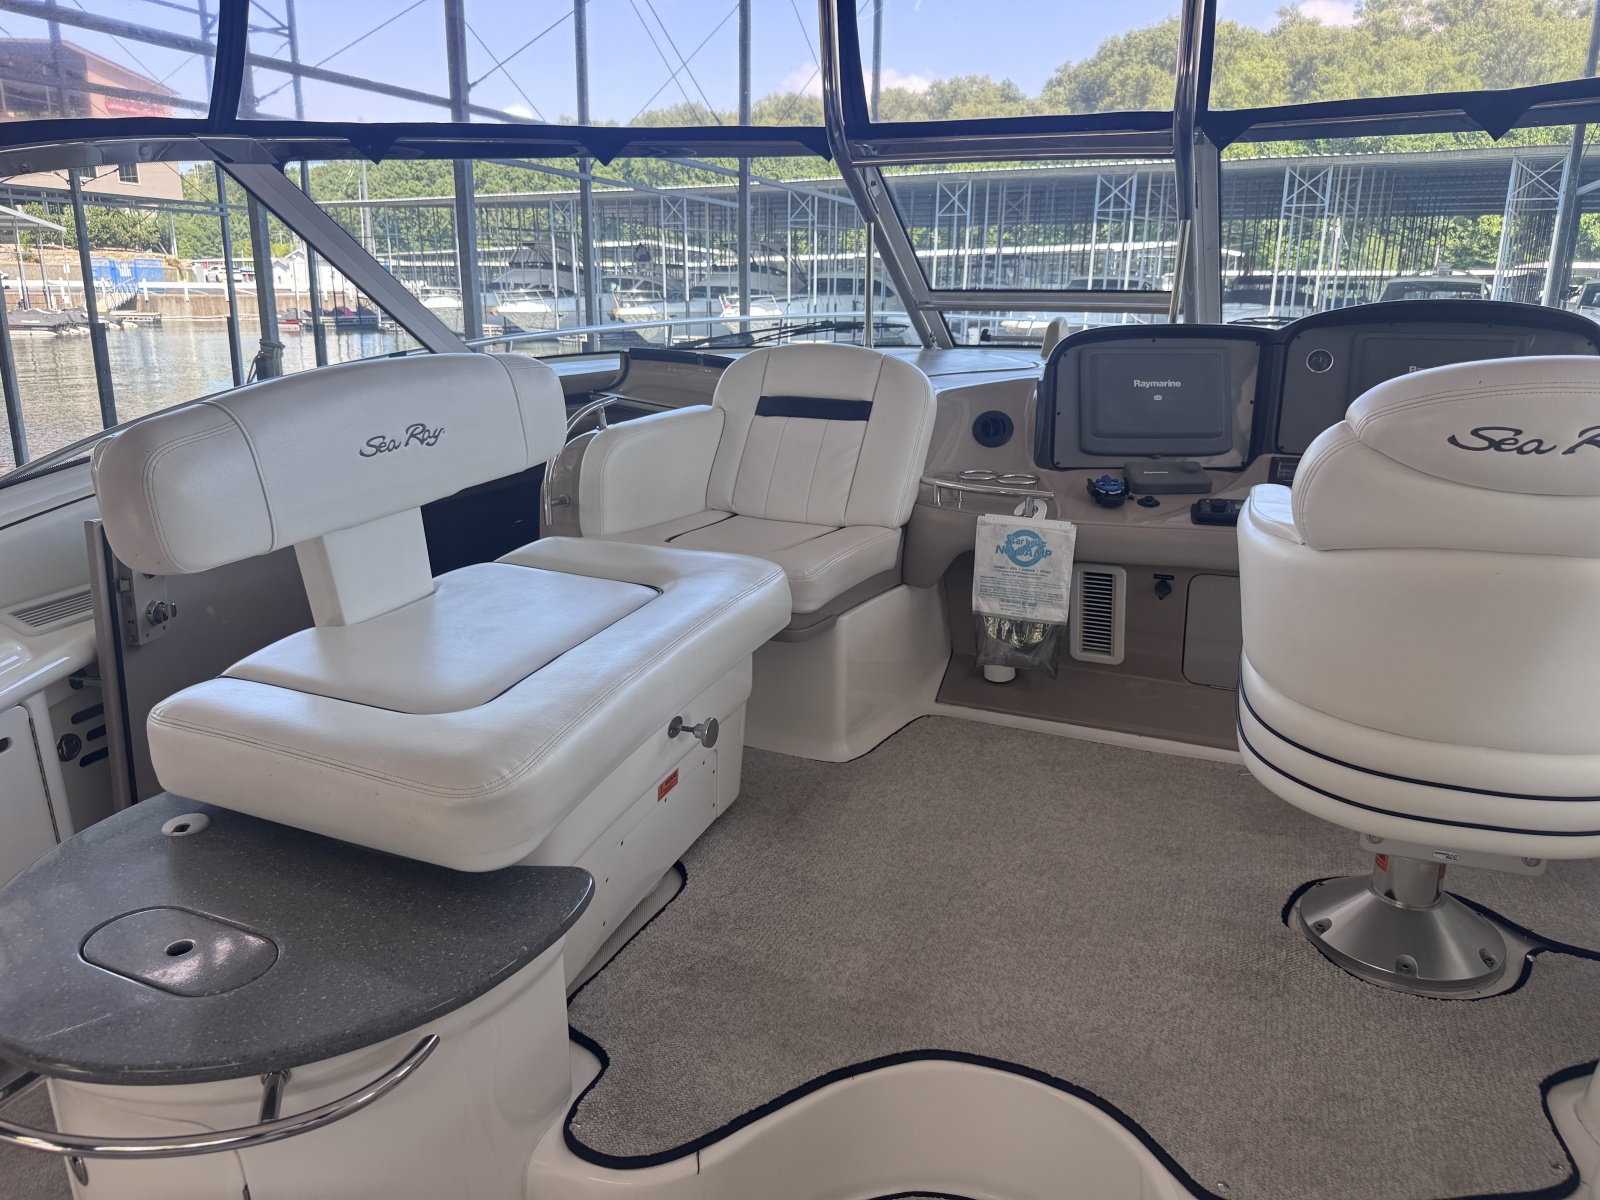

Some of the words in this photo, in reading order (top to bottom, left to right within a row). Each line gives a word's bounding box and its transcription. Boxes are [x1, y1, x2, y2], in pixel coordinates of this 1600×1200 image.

[1133, 379, 1182, 389] Raymarine
[359, 435, 402, 458] Sea
[404, 422, 444, 447] Ray
[1446, 426, 1557, 456] Sea
[995, 544, 1015, 556] NO
[1016, 546, 1052, 559] DAMP
